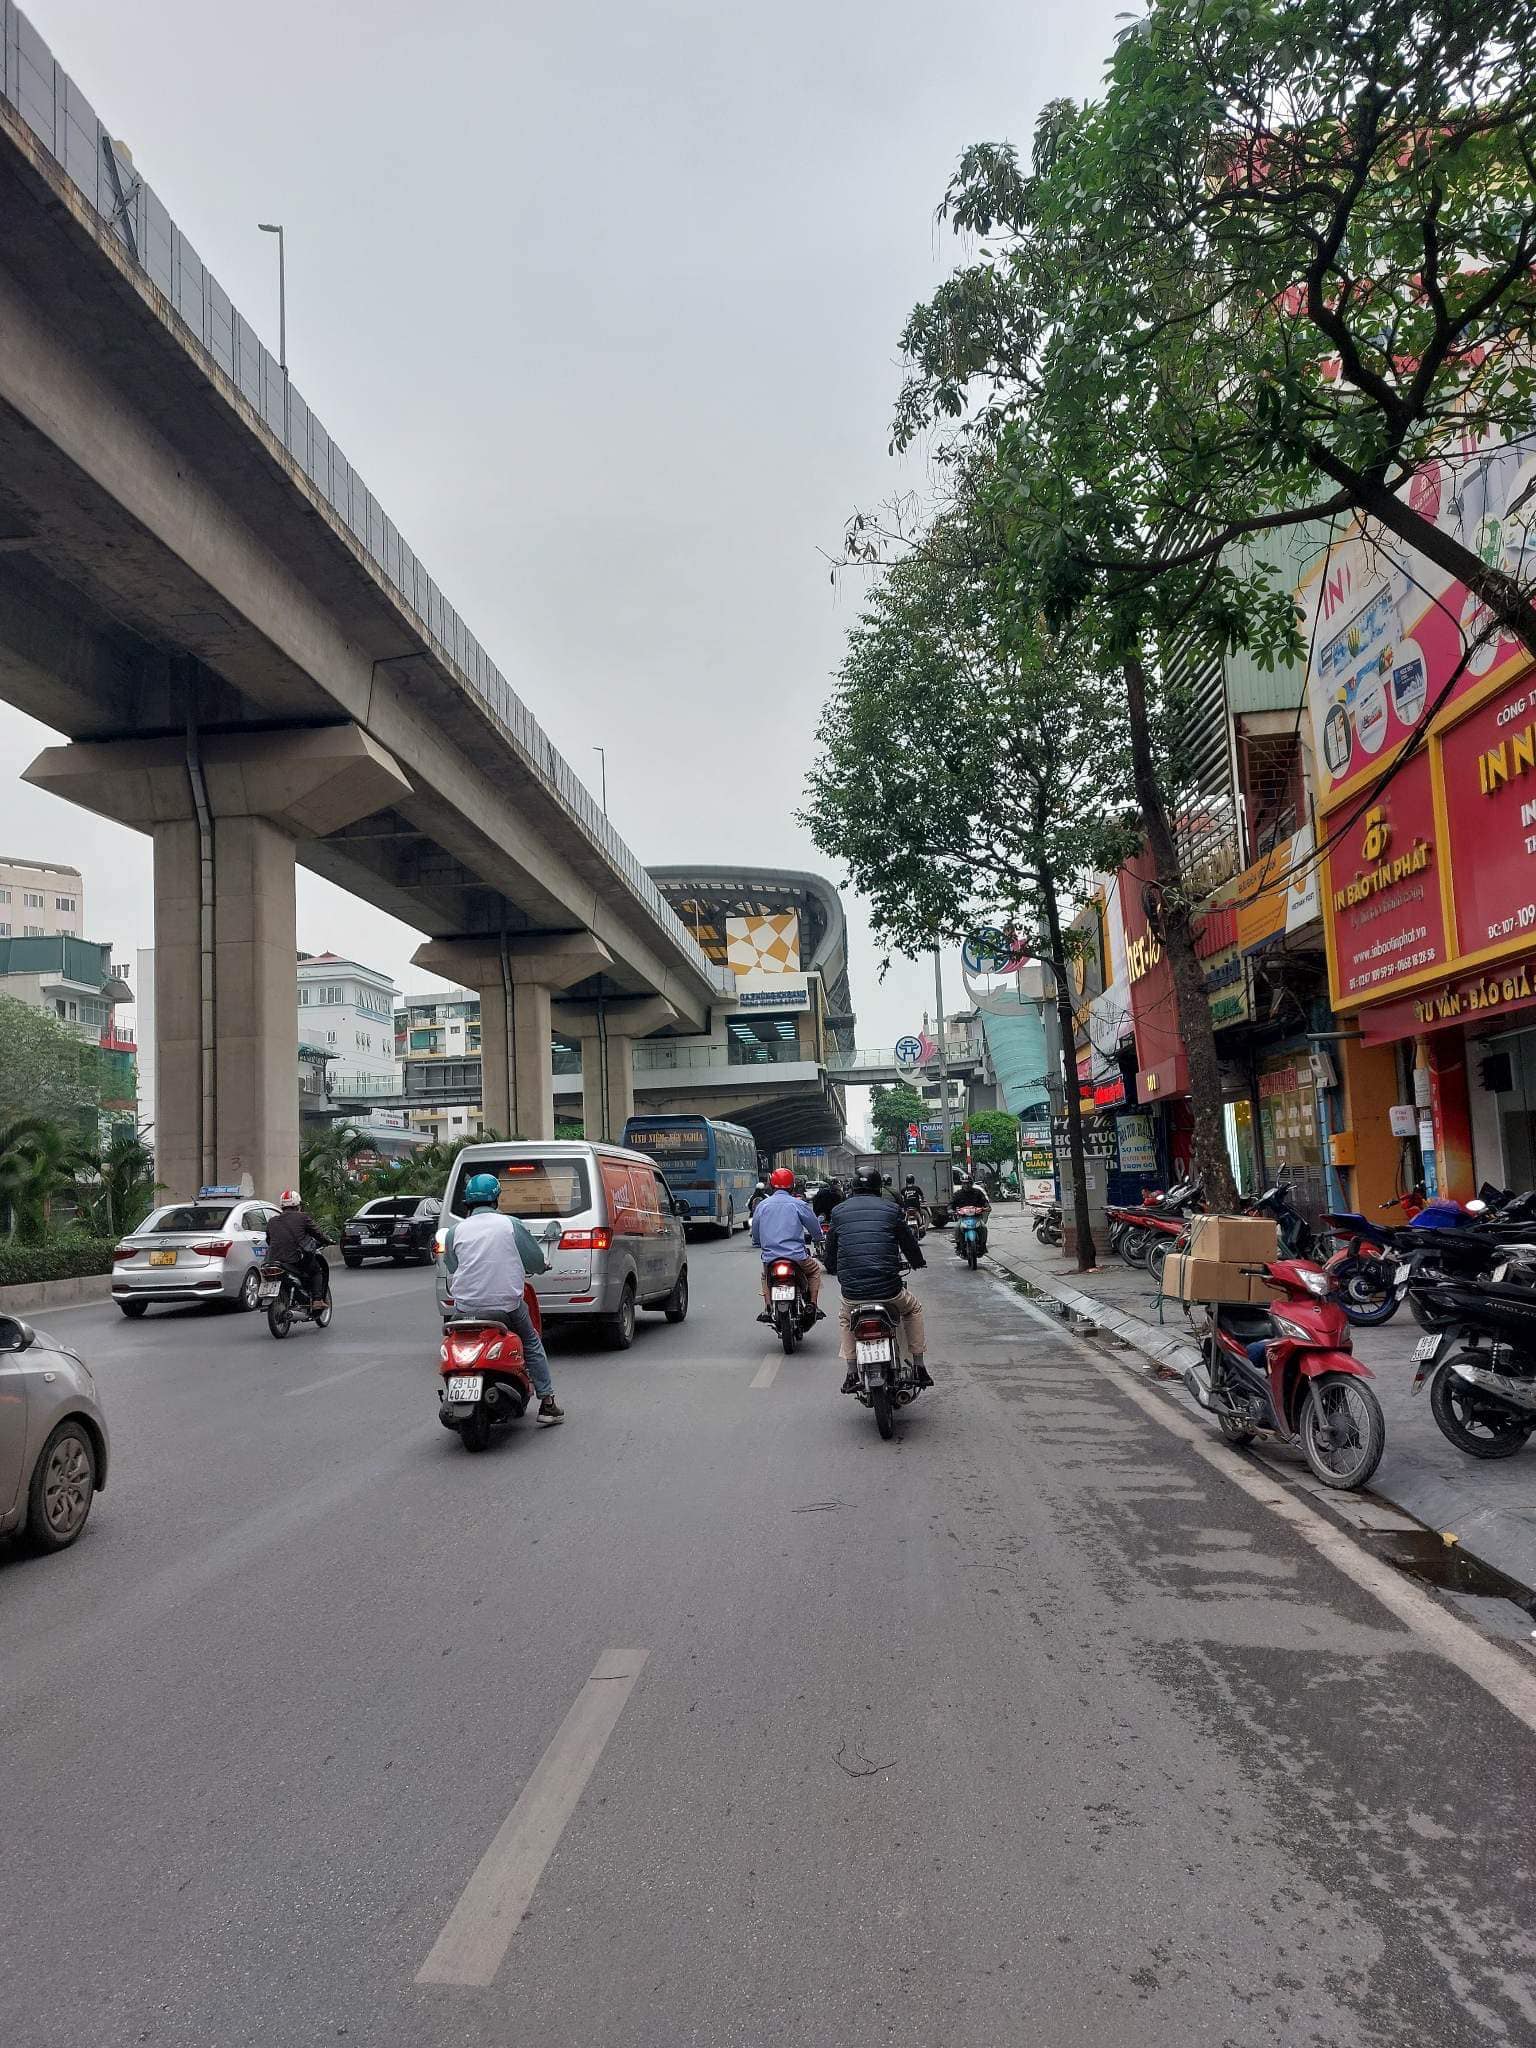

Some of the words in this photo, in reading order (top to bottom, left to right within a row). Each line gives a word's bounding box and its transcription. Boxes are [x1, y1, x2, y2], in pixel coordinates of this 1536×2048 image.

[1496, 697, 1525, 727] CÔNG
[1478, 740, 1508, 795] IN
[1334, 889, 1345, 912] IN
[1372, 859, 1391, 893] TÍN
[1393, 838, 1428, 883] PHÁT
[1353, 925, 1428, 964] www.inbaotinphat.vn
[1469, 977, 1499, 1010] BÁO
[1502, 965, 1531, 1001] GIÁ
[449, 1389, 479, 1401] 402.70
